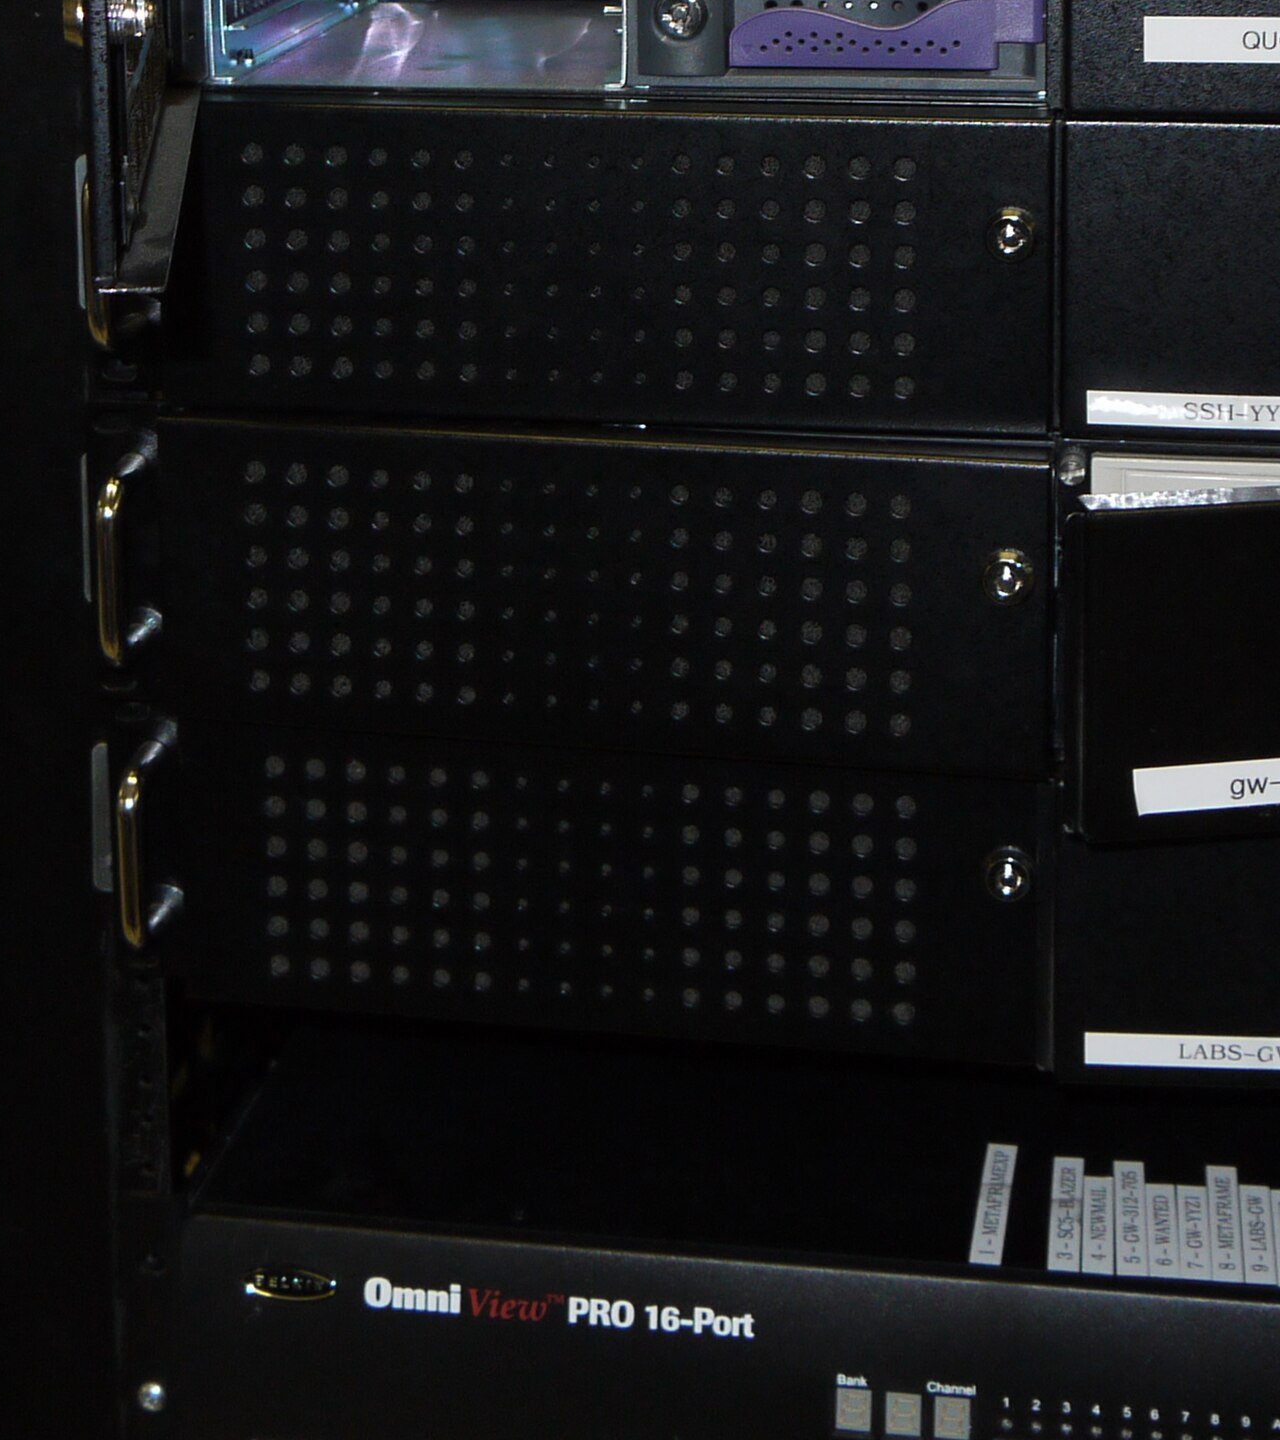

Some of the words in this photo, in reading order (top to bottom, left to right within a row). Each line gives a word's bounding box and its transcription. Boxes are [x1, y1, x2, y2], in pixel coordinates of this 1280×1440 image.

[1090, 1186, 1107, 1240] NEWMAIL
[1153, 1195, 1170, 1245] WANTED
[1215, 1176, 1235, 1250] METAFRAME
[1247, 1195, 1268, 1252] LABS-GW
[1056, 1252, 1073, 1261] 3
[1091, 1253, 1106, 1261] 4
[1124, 1256, 1141, 1264] 5
[1155, 1257, 1172, 1266] 6
[1187, 1261, 1203, 1269] 7
[1219, 1263, 1235, 1271] 8
[1252, 1264, 1268, 1272] 9
[568, 1296, 634, 1329] PRO
[645, 1304, 755, 1339] 16-Port
[836, 1373, 868, 1388] Bank
[926, 1380, 976, 1396] Channel
[1002, 1396, 1010, 1408] 1
[1032, 1399, 1041, 1411] 2
[1062, 1401, 1071, 1413] 3
[1091, 1404, 1101, 1415] 4
[1123, 1406, 1132, 1418] 5
[1150, 1409, 1159, 1420] 6
[1182, 1411, 1190, 1423] 7
[1211, 1414, 1220, 1425] 8
[1242, 1416, 1251, 1427] 9
